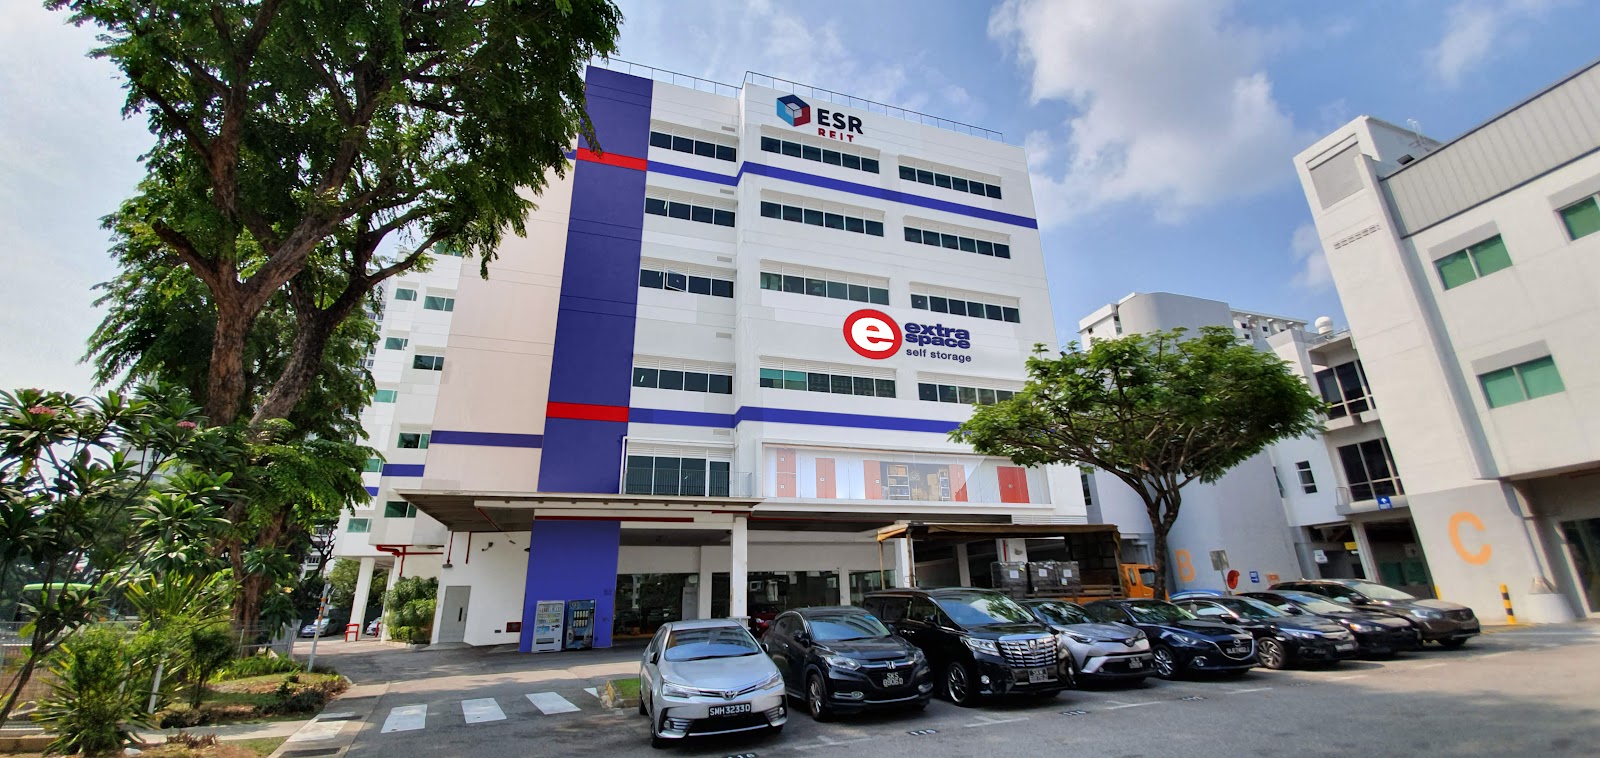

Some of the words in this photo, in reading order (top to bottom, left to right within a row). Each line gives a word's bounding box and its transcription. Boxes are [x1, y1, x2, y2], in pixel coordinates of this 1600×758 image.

[817, 108, 864, 135] ESR
[817, 127, 854, 143] REIT
[904, 322, 970, 340] extra
[904, 333, 971, 349] space
[906, 348, 927, 358] self
[930, 351, 972, 363] storage
[1447, 511, 1492, 566] C
[1175, 549, 1195, 582] B
